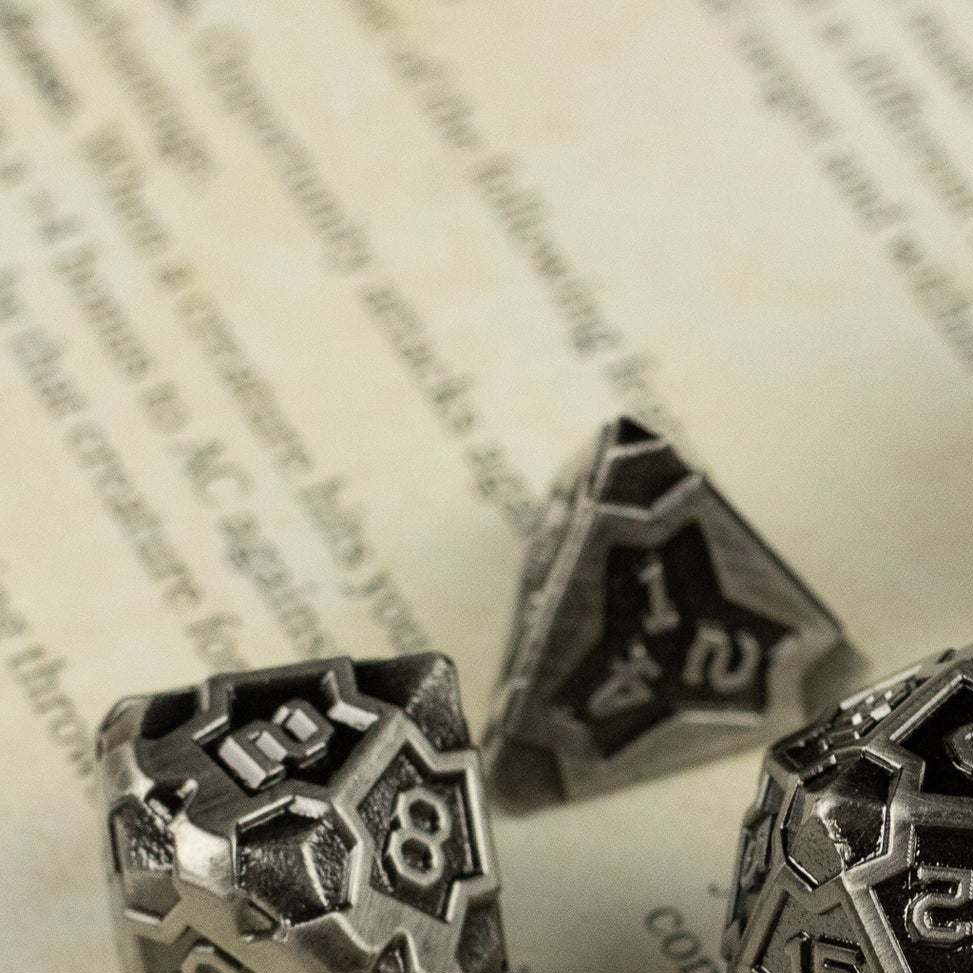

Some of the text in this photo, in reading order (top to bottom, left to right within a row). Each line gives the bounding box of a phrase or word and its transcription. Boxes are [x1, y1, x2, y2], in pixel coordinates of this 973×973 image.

[637, 557, 682, 634] 1
[587, 638, 664, 716] 4
[682, 626, 763, 693] 2
[389, 787, 449, 886] 8
